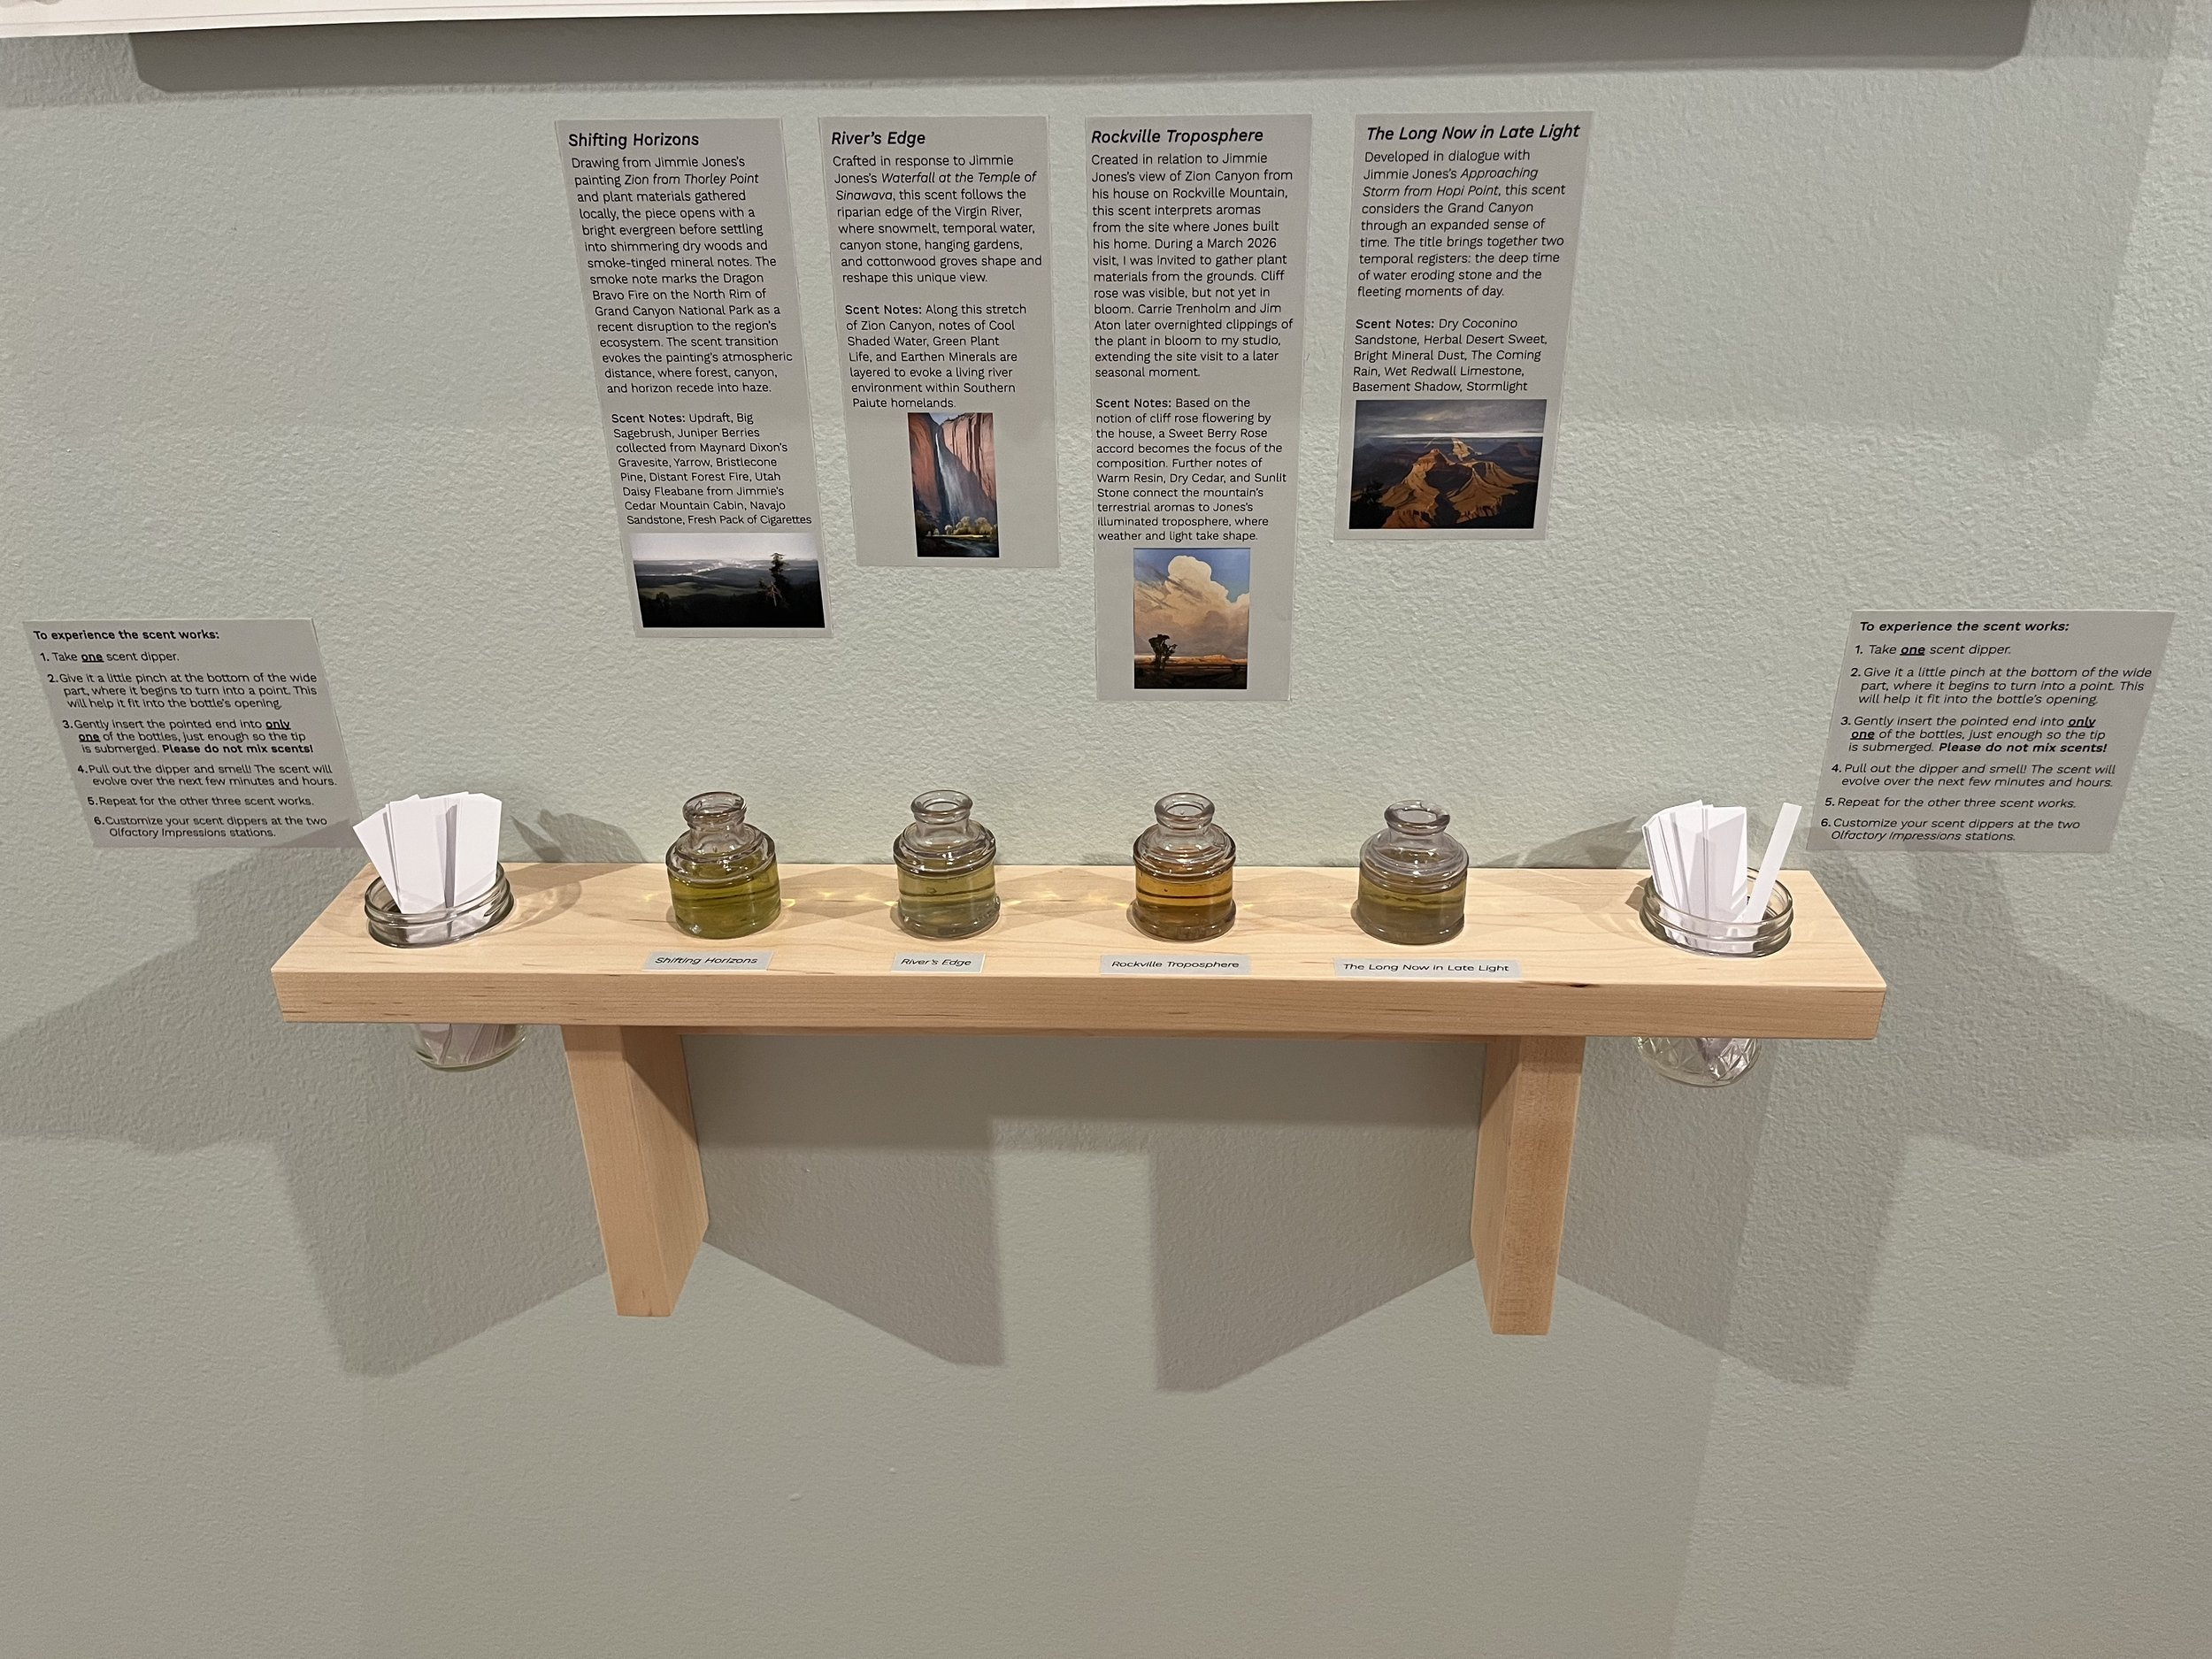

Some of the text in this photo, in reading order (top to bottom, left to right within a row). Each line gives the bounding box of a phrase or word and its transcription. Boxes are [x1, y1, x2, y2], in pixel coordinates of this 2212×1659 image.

[887, 129, 926, 148] Edge
[1091, 127, 1263, 146] Rockville Troposphere
[1367, 122, 1580, 143] The Long Now in Late Light
[568, 132, 699, 150] Shifting Horizons
[832, 154, 1013, 168] Crafted in response to Jimmie
[1091, 151, 1267, 165] Created in relation to Jimmie
[1364, 148, 1530, 165] Developed in dialogue with
[576, 189, 746, 204] and plant materials gathered
[1092, 204, 1261, 218] this scent interprets aromas
[1361, 201, 1533, 215] considers the Grand Canyon
[581, 222, 764, 238] bright evergreen before settling
[837, 221, 1034, 235] where snowmelt, temporal water,
[1093, 238, 1110, 249] his
[1113, 238, 1149, 249] home.
[1154, 238, 1193, 251] During
[1207, 236, 1242, 248] March
[1247, 237, 1276, 248] 2026
[844, 303, 1026, 317] Scent Notes: Along this stretch
[1355, 318, 1517, 331] Scent Notes: Dry Coconino
[847, 334, 1000, 347] Shaded Water, Green Plant
[1354, 333, 1547, 346] Sandstone, Herbal Desert Sweet,
[850, 381, 1015, 393] environment within Southern
[1352, 380, 1527, 393] Basement Shadow, Stormlight
[1095, 398, 1129, 408] Scent
[1133, 398, 1171, 408] Notes:
[1175, 396, 1210, 407] Based
[1231, 396, 1250, 407] the
[611, 411, 754, 425] Scent Notes: Updraft, Big
[613, 427, 759, 440] Sagebrush, Juniper Berries
[626, 514, 811, 526] Sandstone, Fresh Pack of Cigarettes
[1097, 530, 1257, 542] weather and light take shape.
[1859, 620, 2070, 634] To experience the scent works:
[32, 628, 219, 641] To experience the scent works:
[39, 650, 179, 663] 1. Take one scent dipper.
[1855, 643, 2010, 657] 1. Take one scent dipper.
[81, 743, 313, 755] is submerged. Please do not mix scents!
[1847, 741, 2107, 754] is submerged. Please do not mix scents!
[109, 826, 275, 839] Olfactory Impressions stations.
[1831, 829, 2015, 841] Olfactory Impressions stations.
[655, 956, 702, 965] Shifting
